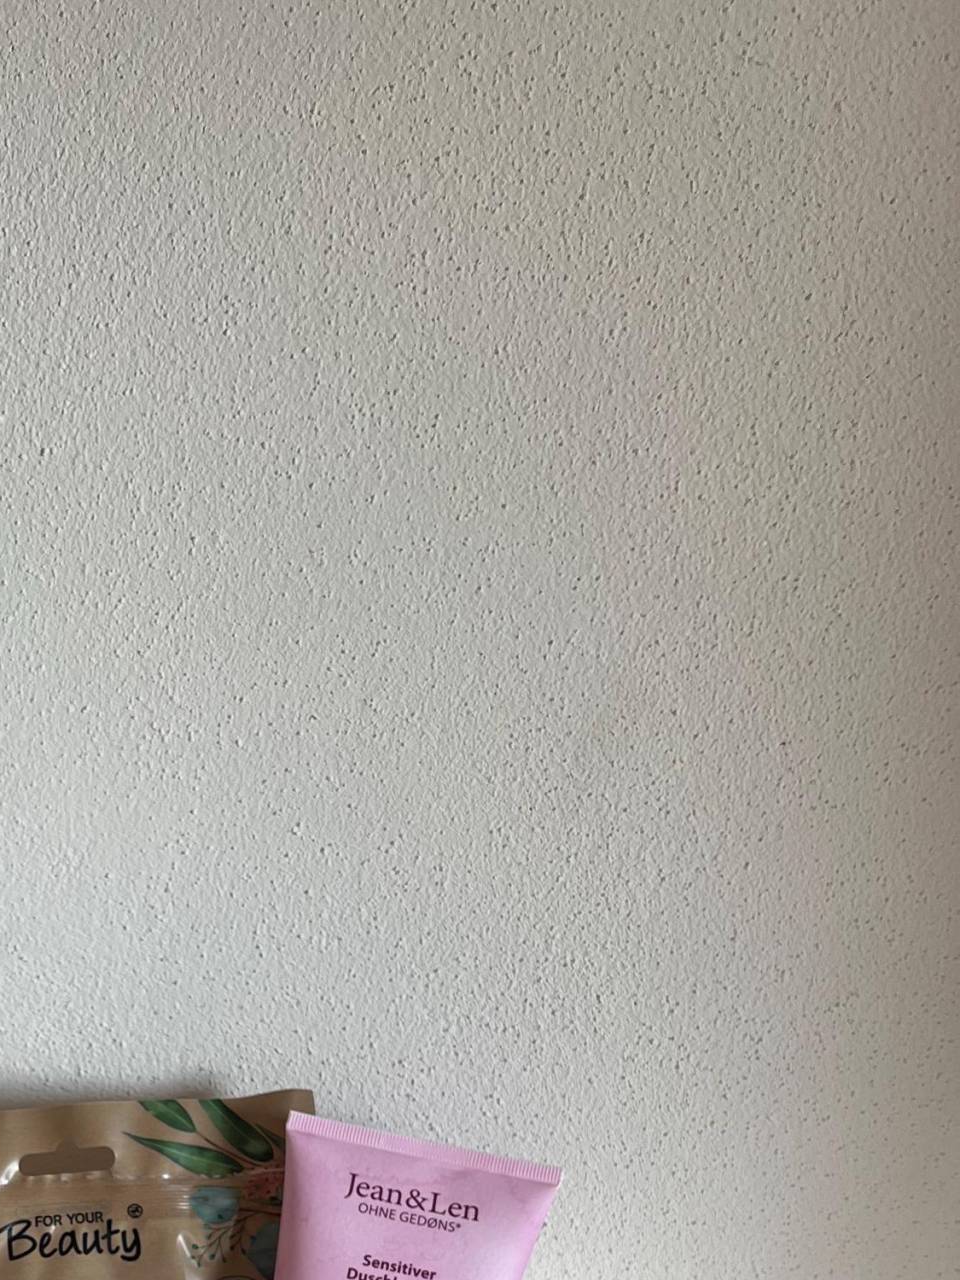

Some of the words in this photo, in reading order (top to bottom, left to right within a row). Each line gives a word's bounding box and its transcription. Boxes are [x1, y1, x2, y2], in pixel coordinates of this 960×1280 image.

[344, 1172, 480, 1222] Jean&Len
[34, 1214, 63, 1228] FOR
[66, 1211, 105, 1225] YOUR
[358, 1202, 396, 1220] OHNE
[362, 1254, 437, 1280] Sensitiver
